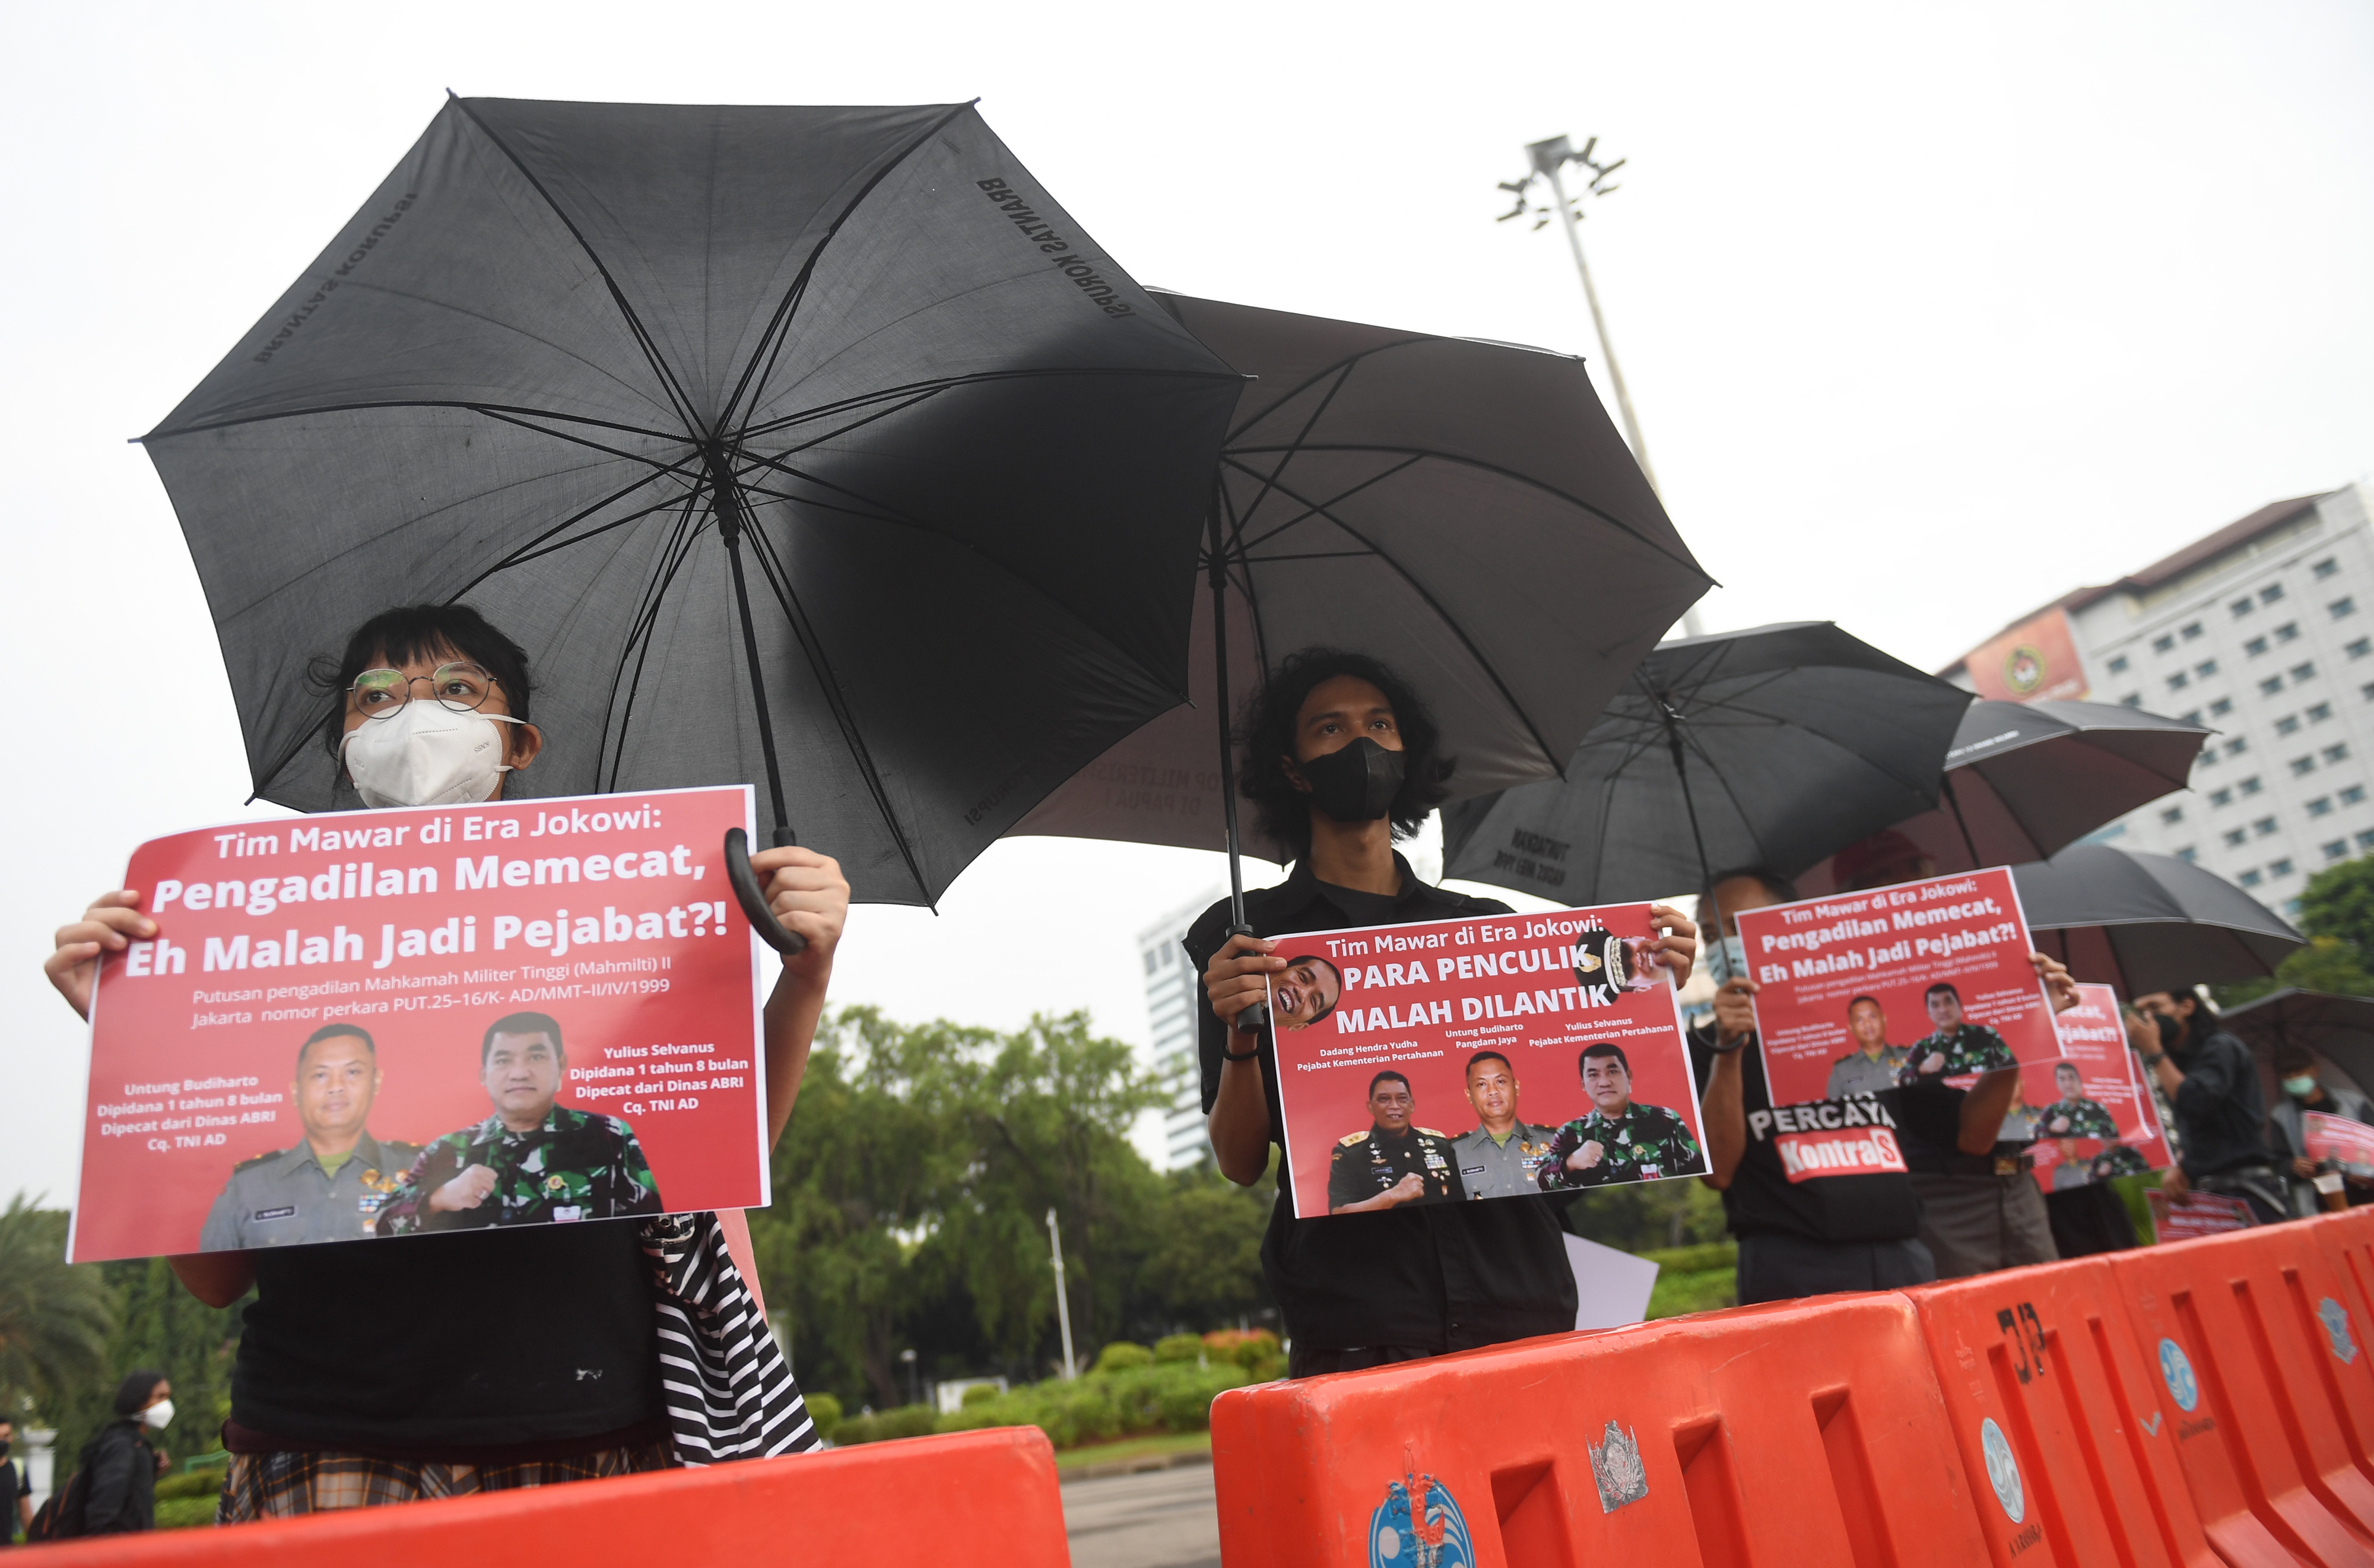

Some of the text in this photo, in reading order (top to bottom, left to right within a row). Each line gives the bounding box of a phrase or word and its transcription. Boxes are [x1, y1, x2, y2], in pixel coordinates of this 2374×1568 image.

[214, 804, 661, 858] Tim Mawar di Era Jokowi:
[152, 845, 704, 915] Pengadilan Memecat,
[1780, 878, 1977, 924] Tim Mawar di Era Jokowi:
[126, 901, 726, 976] Eh Malah Jadi Pejabat?!
[1326, 914, 1603, 957] Tim Mawar di Era Jokowi:
[1762, 897, 2001, 953] Pengadilan Memecat,
[1759, 922, 2017, 985] Eh Malah Jadi Pejabat?!
[193, 956, 670, 1003] Putusan pengadilan Mahkamah Militer Tinggi (Mahmilti) II
[1343, 944, 1592, 991] PARA PENCULIK
[190, 1011, 252, 1029] Jakarta
[261, 1007, 319, 1021] nomor
[323, 1001, 388, 1020] perkara
[1336, 983, 1611, 1033] MALAH DILANTIK
[1445, 1024, 1523, 1037] Untung Budiharto
[1529, 1024, 1674, 1047] Pejabat Kementerian Pertahanan
[1565, 1018, 1632, 1030] Yulius Selvanus
[604, 1043, 714, 1058] Yulius Selvanus
[1320, 1040, 1417, 1056] Dadang Hendra Yudha
[1455, 1036, 1516, 1048] Pangdam Jaya
[570, 1058, 748, 1081] Dipidana 1 tahun 8 bulan
[1297, 1050, 1443, 1071] Pejabat Kementerian Pertahanan
[125, 1076, 258, 1095] Untung Budiharto
[576, 1077, 743, 1100] Dipecat dari Dinas ABRI
[97, 1092, 283, 1118] Dipidana 1 tahun 8 bulan
[623, 1097, 699, 1115] Cq. TNI AD
[101, 1110, 275, 1137] Dipecat dari Dinas ABRI
[1748, 1101, 1897, 1141] PERCAYA
[147, 1133, 226, 1152] Cq. TNI AD
[1780, 1130, 1903, 1175] KontraS
